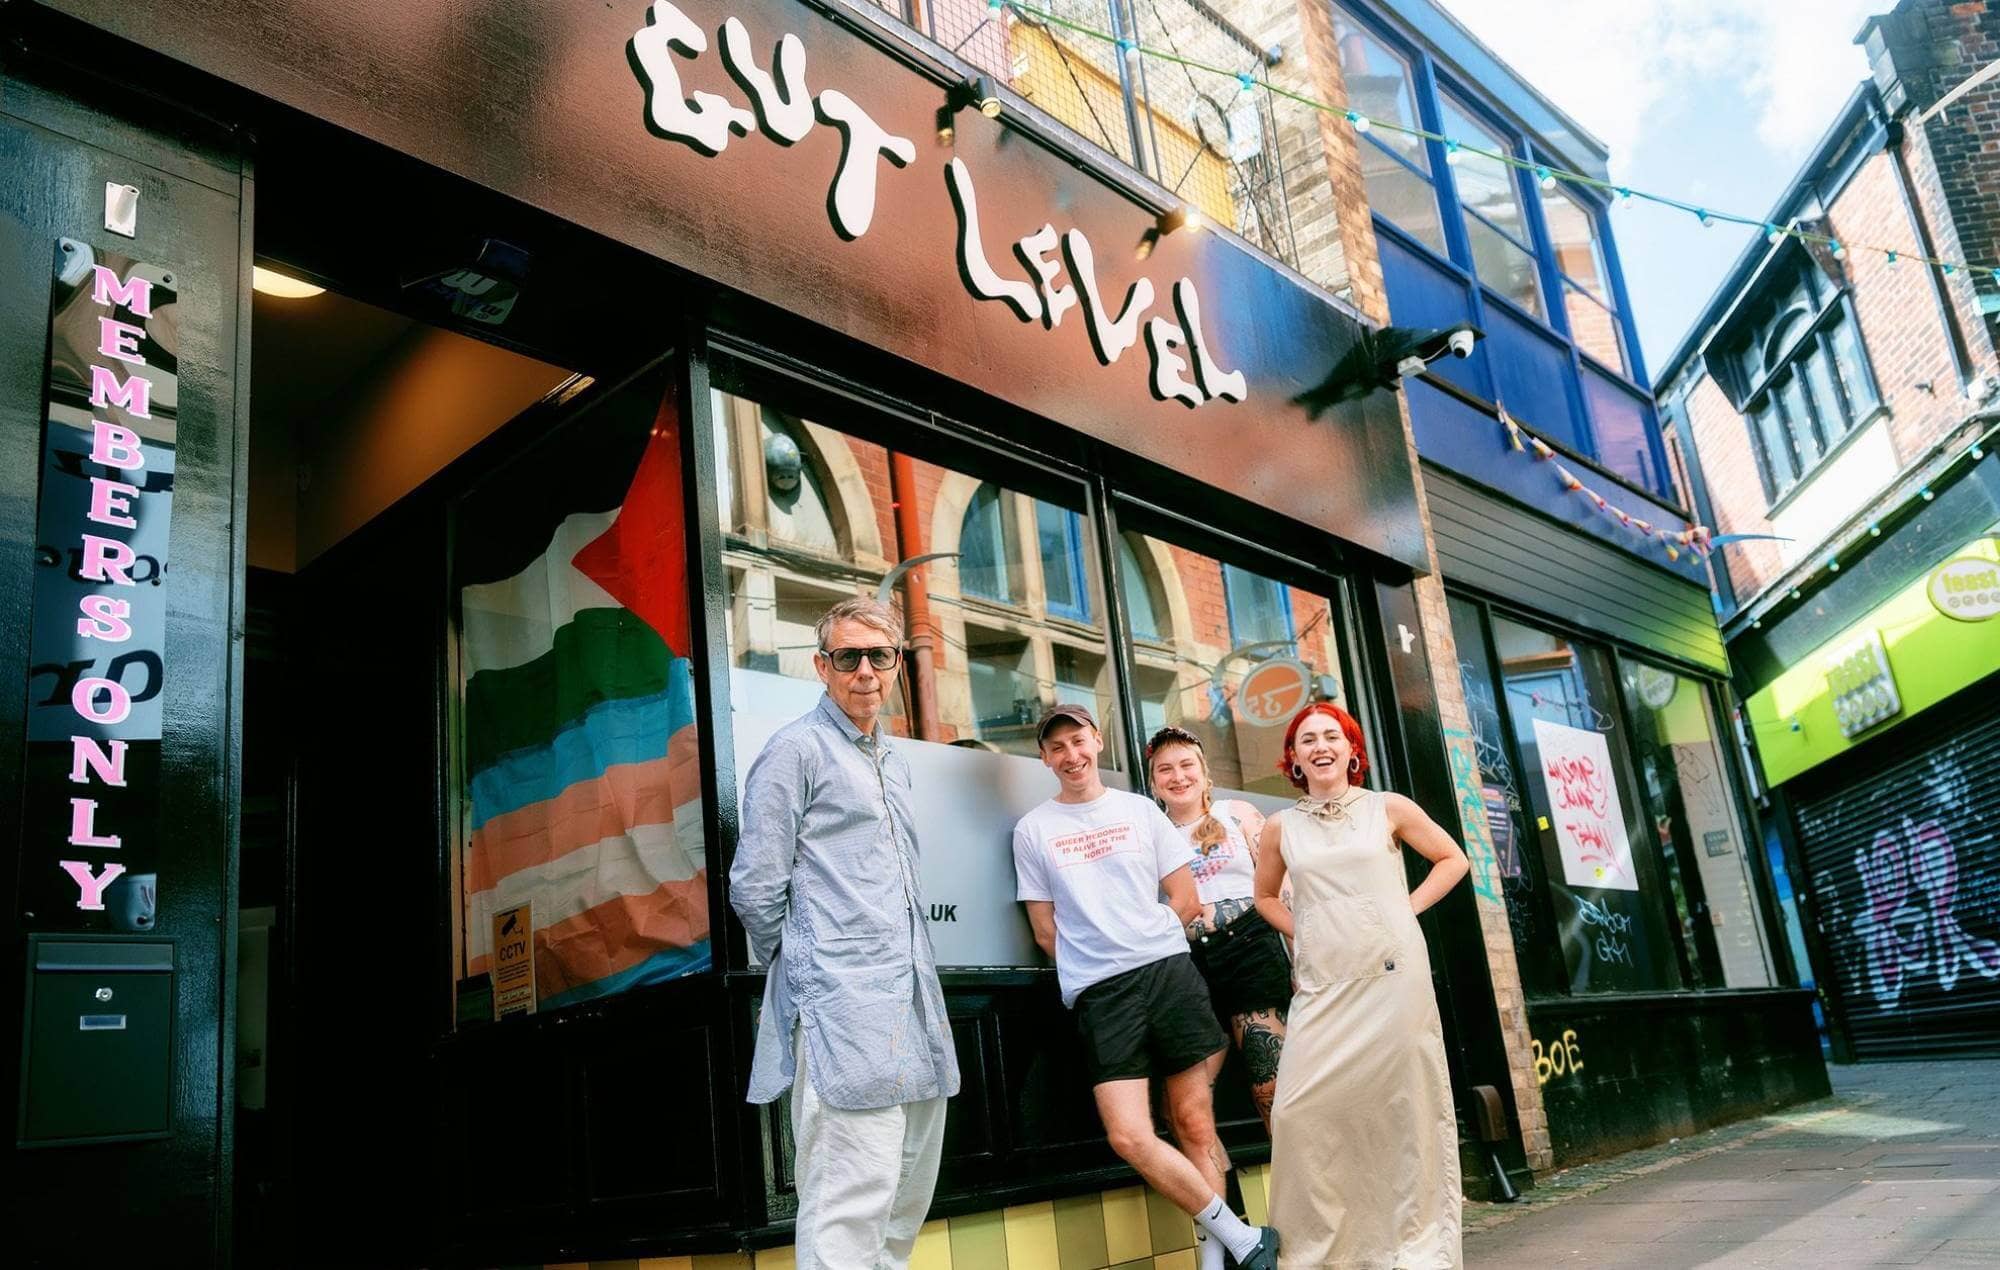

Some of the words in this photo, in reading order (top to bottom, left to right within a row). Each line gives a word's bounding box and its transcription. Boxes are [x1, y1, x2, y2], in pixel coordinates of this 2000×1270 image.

[627, 0, 916, 242] GUT
[945, 157, 1247, 408] LEVEL
[77, 263, 153, 643] MEMBERS
[59, 677, 131, 911] ONLY
[1055, 837, 1085, 848] QUEER
[1086, 826, 1130, 841] HEDONISM
[1073, 841, 1097, 853] ALIVE
[1110, 834, 1127, 842] THE
[1084, 845, 1113, 860] NORTH
[500, 941, 526, 961] CCTV
